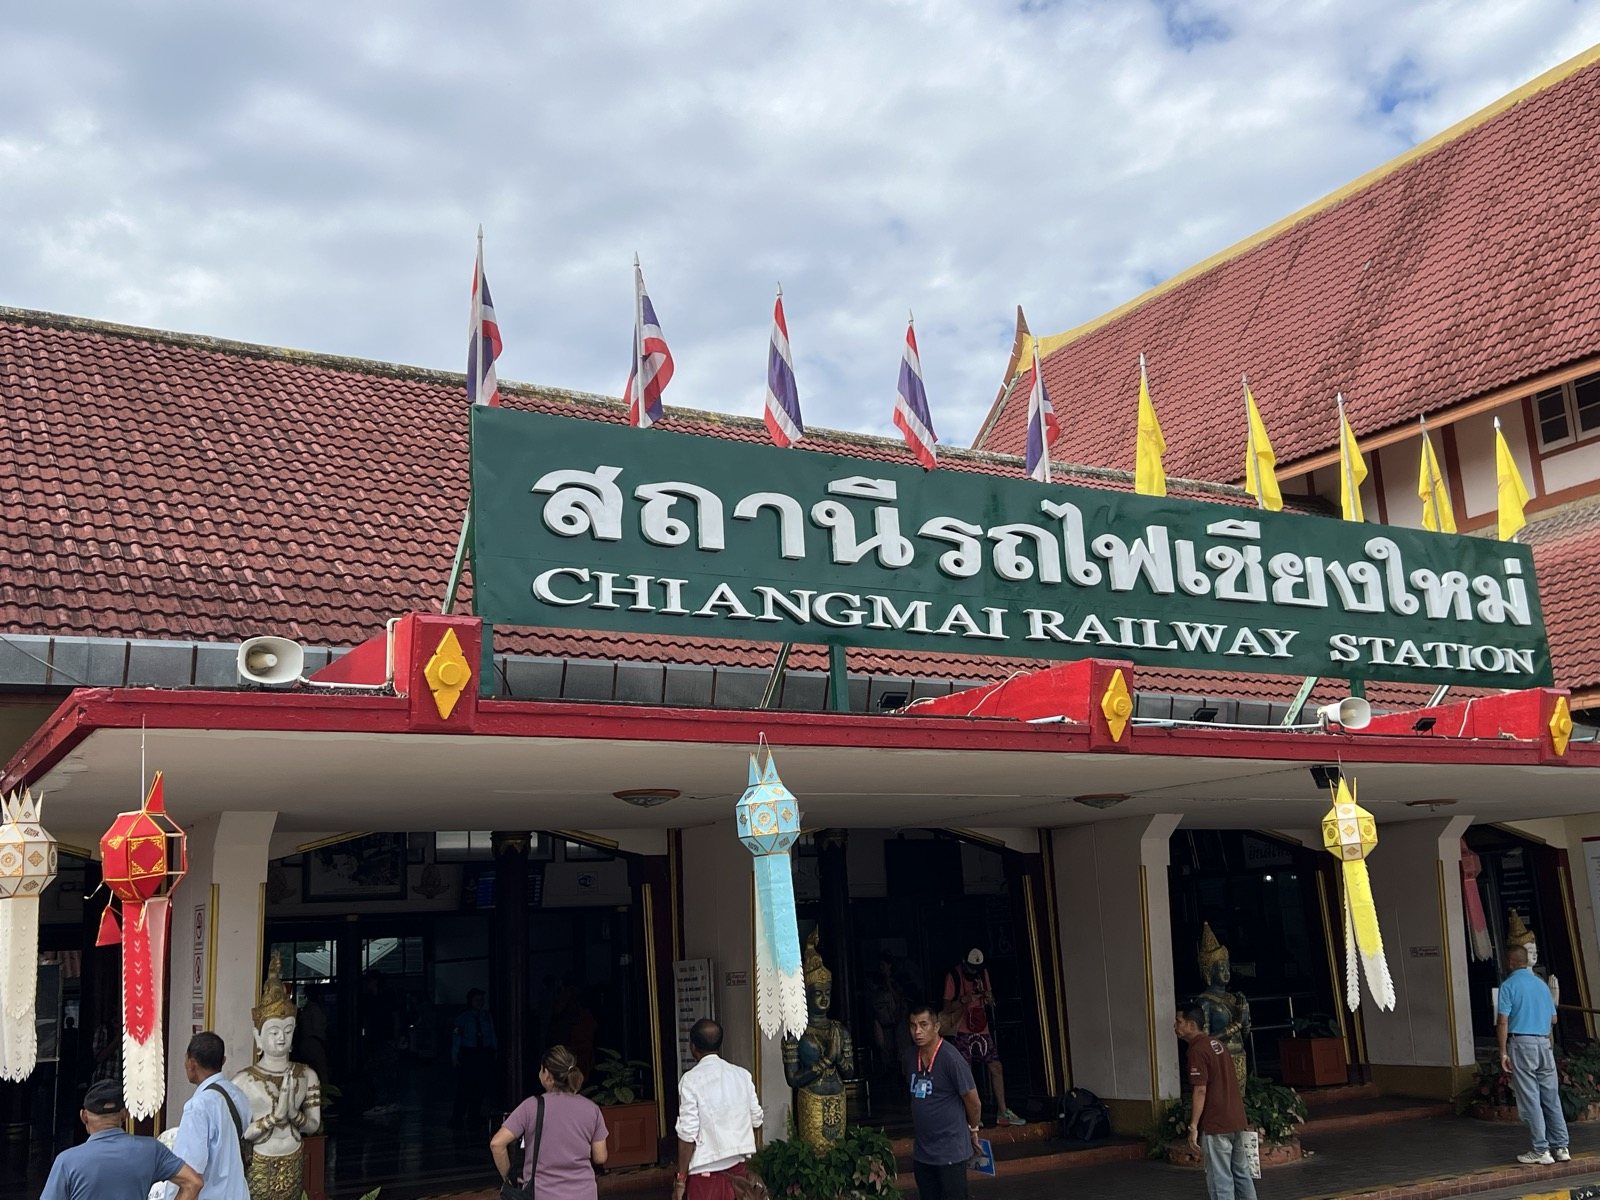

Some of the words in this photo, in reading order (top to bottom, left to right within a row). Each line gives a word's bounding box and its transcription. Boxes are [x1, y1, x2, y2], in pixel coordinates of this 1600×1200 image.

[531, 465, 1533, 627] สถานีรถไฟเชียงใหม่
[531, 566, 1011, 640] CHIANGMAI
[1022, 608, 1300, 659] RAILWAY
[1328, 632, 1536, 675] STATION
[910, 1072, 933, 1096] Le
